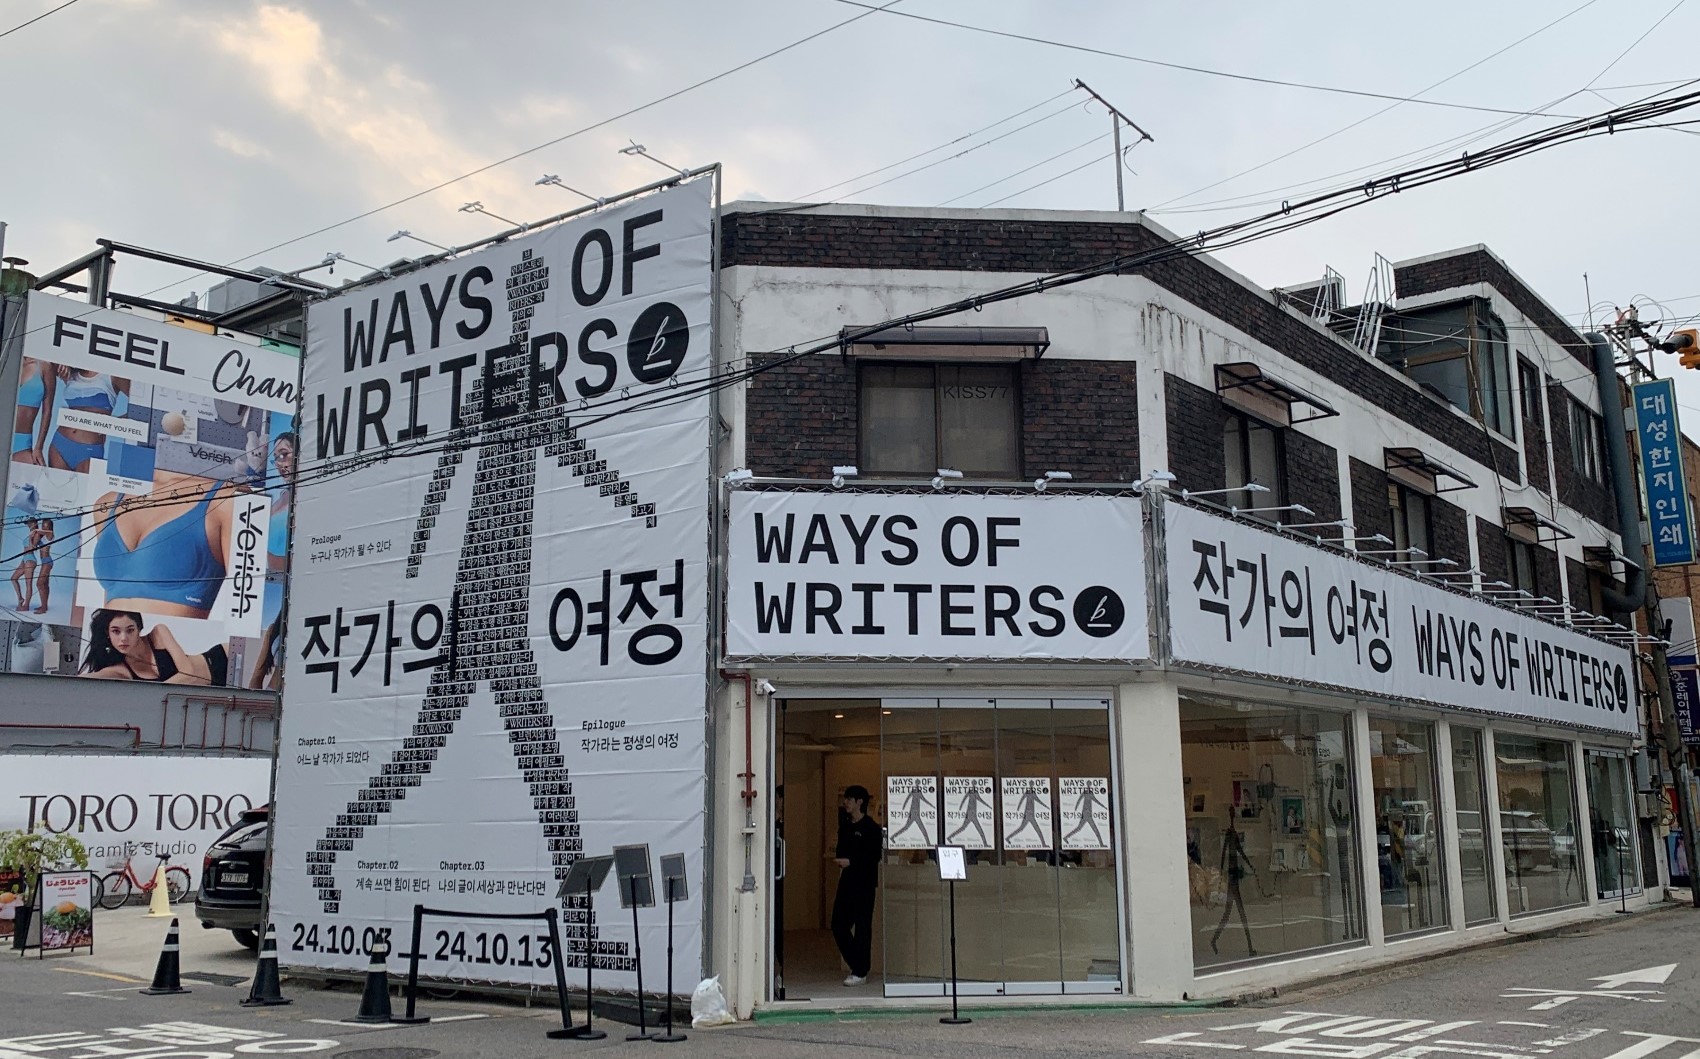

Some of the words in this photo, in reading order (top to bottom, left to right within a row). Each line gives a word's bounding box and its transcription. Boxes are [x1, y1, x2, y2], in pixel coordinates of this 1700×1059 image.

[344, 265, 494, 374] WAYS
[571, 208, 663, 307] OF
[53, 314, 186, 376] FEEL
[316, 317, 618, 460] WRITERS
[943, 385, 1010, 399] KISS77
[64, 414, 78, 422] YOU
[93, 420, 112, 429] WHAT
[113, 425, 127, 433] YOU
[128, 428, 143, 436] FEEL
[1642, 393, 1684, 546] 대성한지인쇄
[311, 534, 342, 546] Prologue
[754, 512, 919, 566] WAYS
[941, 515, 1021, 567] OF
[310, 549, 332, 564] 누구나
[334, 545, 355, 560] 작가가
[357, 544, 365, 557] 될
[367, 542, 375, 555] 수
[376, 539, 392, 553] 있다
[754, 581, 1066, 638] WRITERS
[300, 589, 460, 695] 작가의
[549, 558, 685, 667] 여정
[1192, 538, 1316, 656] 작가의
[1327, 579, 1393, 674] 여정
[1412, 604, 1485, 687] WAYS
[1491, 627, 1521, 692] OF
[1524, 637, 1615, 713] WRITERS
[582, 719, 626, 732] Epilogue
[298, 736, 336, 748] Chapter.01
[581, 737, 620, 753] 작가라는
[623, 734, 655, 751] 평생의
[657, 733, 679, 749] 여정
[322, 752, 343, 765] 작가가
[346, 750, 369, 764] 되었다
[892, 778, 913, 786] WAYS
[921, 778, 932, 786] OF
[949, 779, 970, 787] WAYS
[978, 779, 989, 787] OF
[1006, 779, 1028, 787] WAYS
[1035, 779, 1046, 787] OF
[1063, 779, 1085, 787] WAYS
[1093, 779, 1104, 787] OF
[19, 793, 138, 835] TORO
[144, 839, 197, 856] studio
[357, 860, 399, 872] Chapter.02
[439, 860, 485, 872] Chapter.03
[355, 877, 373, 891] 계속
[374, 878, 392, 892] 쓰면
[394, 877, 411, 893] 힘이
[412, 878, 431, 893] 된다
[438, 878, 457, 893] 나의
[457, 879, 475, 894] 글이
[476, 879, 506, 895] 세상과
[507, 880, 547, 896] 만난다면
[435, 928, 553, 970] 24.10.13
